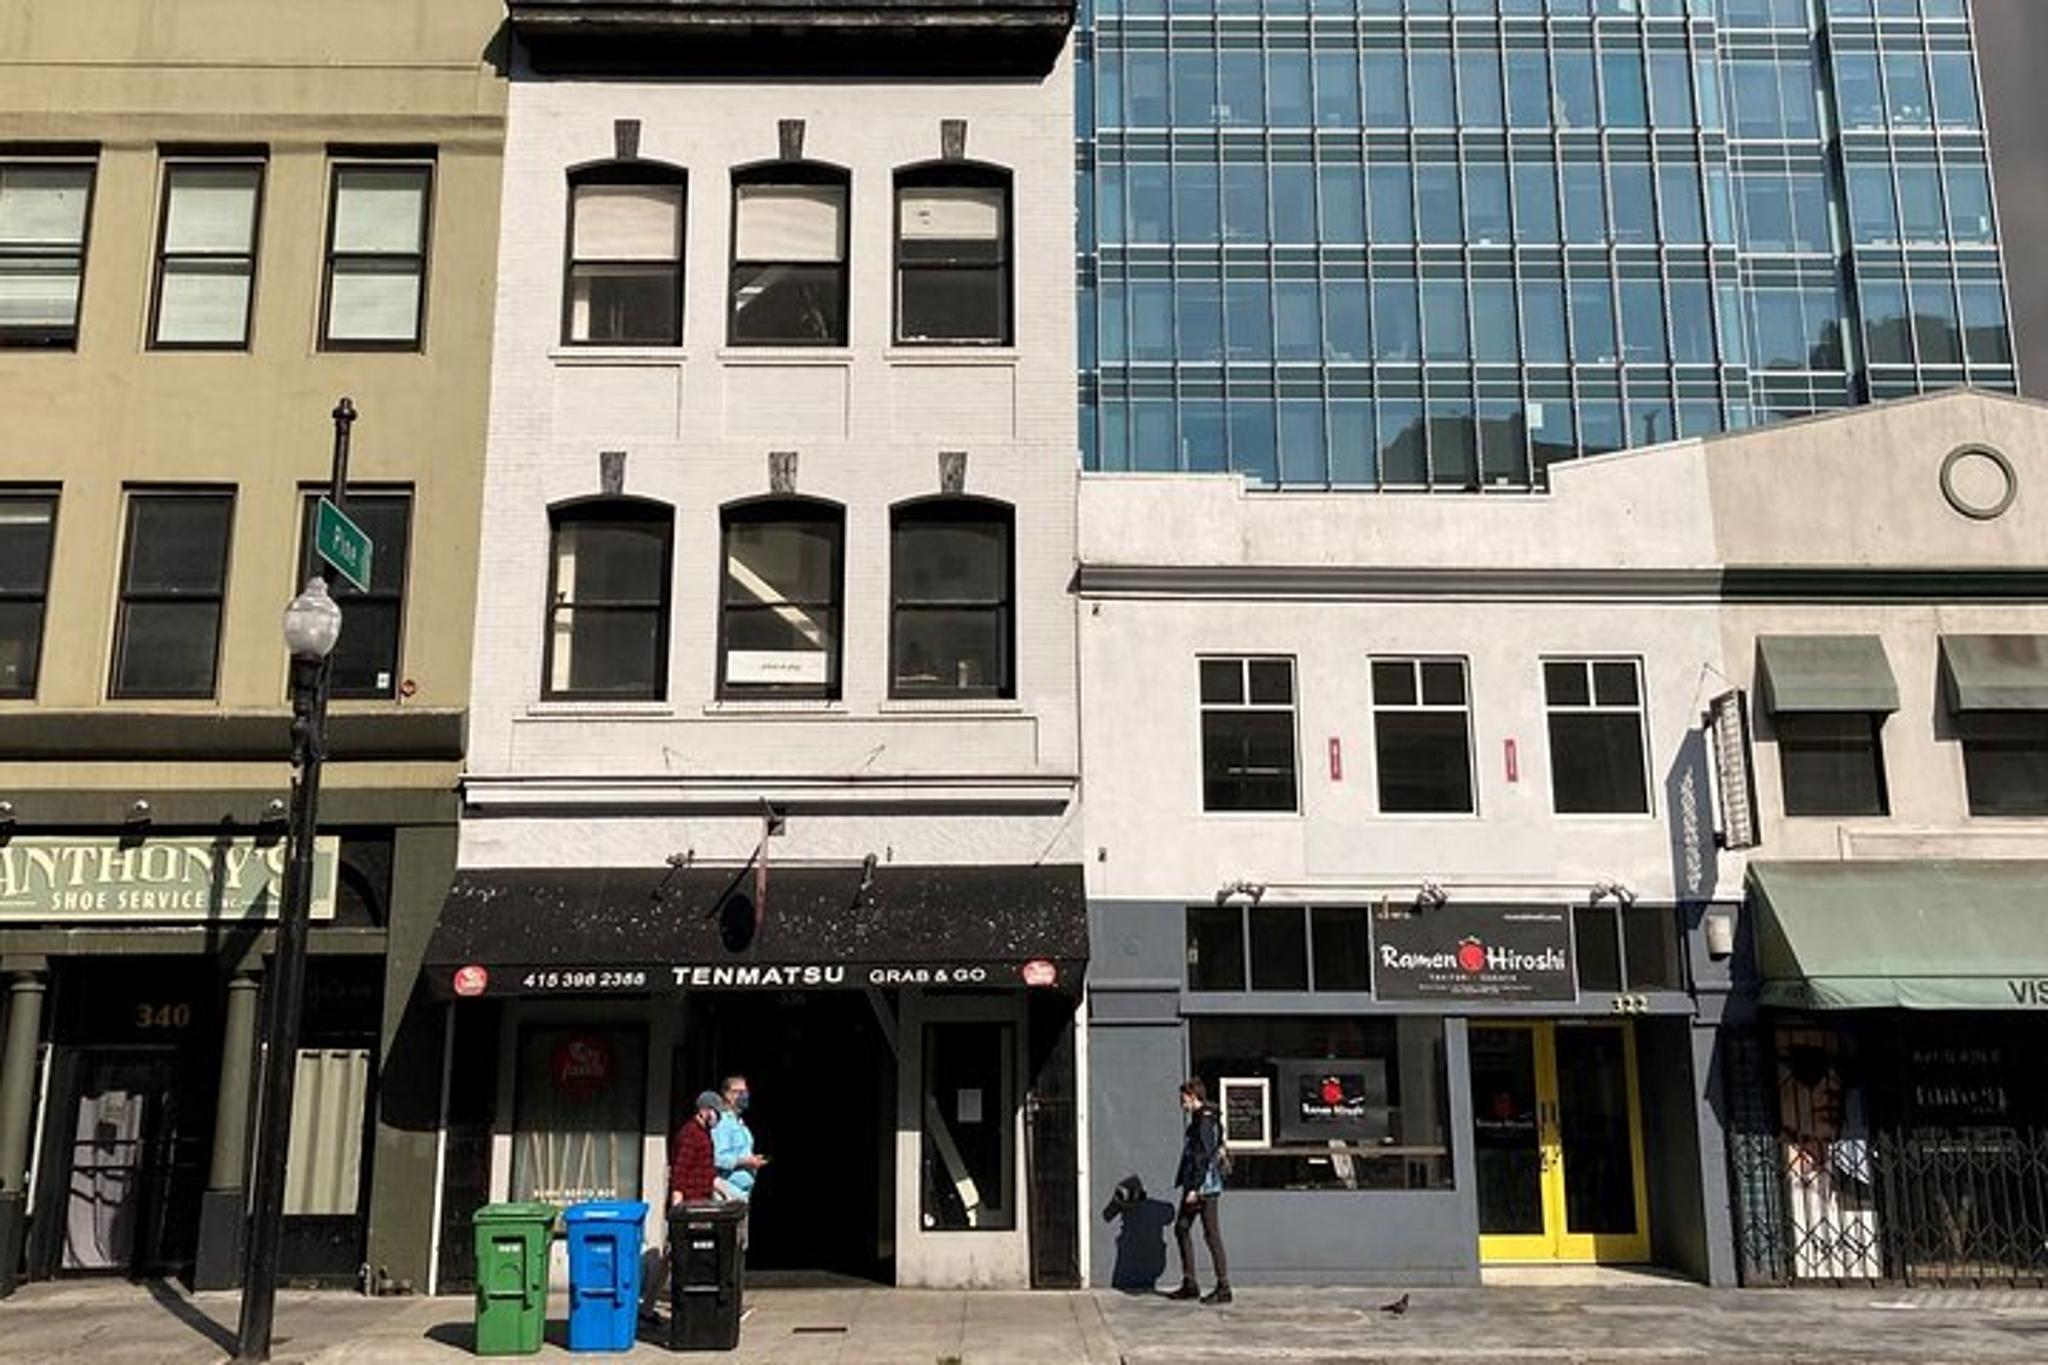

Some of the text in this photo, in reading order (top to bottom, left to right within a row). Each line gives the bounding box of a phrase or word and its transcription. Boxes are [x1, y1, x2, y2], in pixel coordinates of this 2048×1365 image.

[51, 892, 105, 910] SHOE
[117, 889, 204, 909] SERVICE
[1380, 945, 1565, 971] Ramen Hiroshi
[523, 972, 558, 987] 415
[672, 966, 844, 985] TENMATSU
[869, 969, 986, 983] GRAB & GO
[135, 1003, 191, 1028] 340
